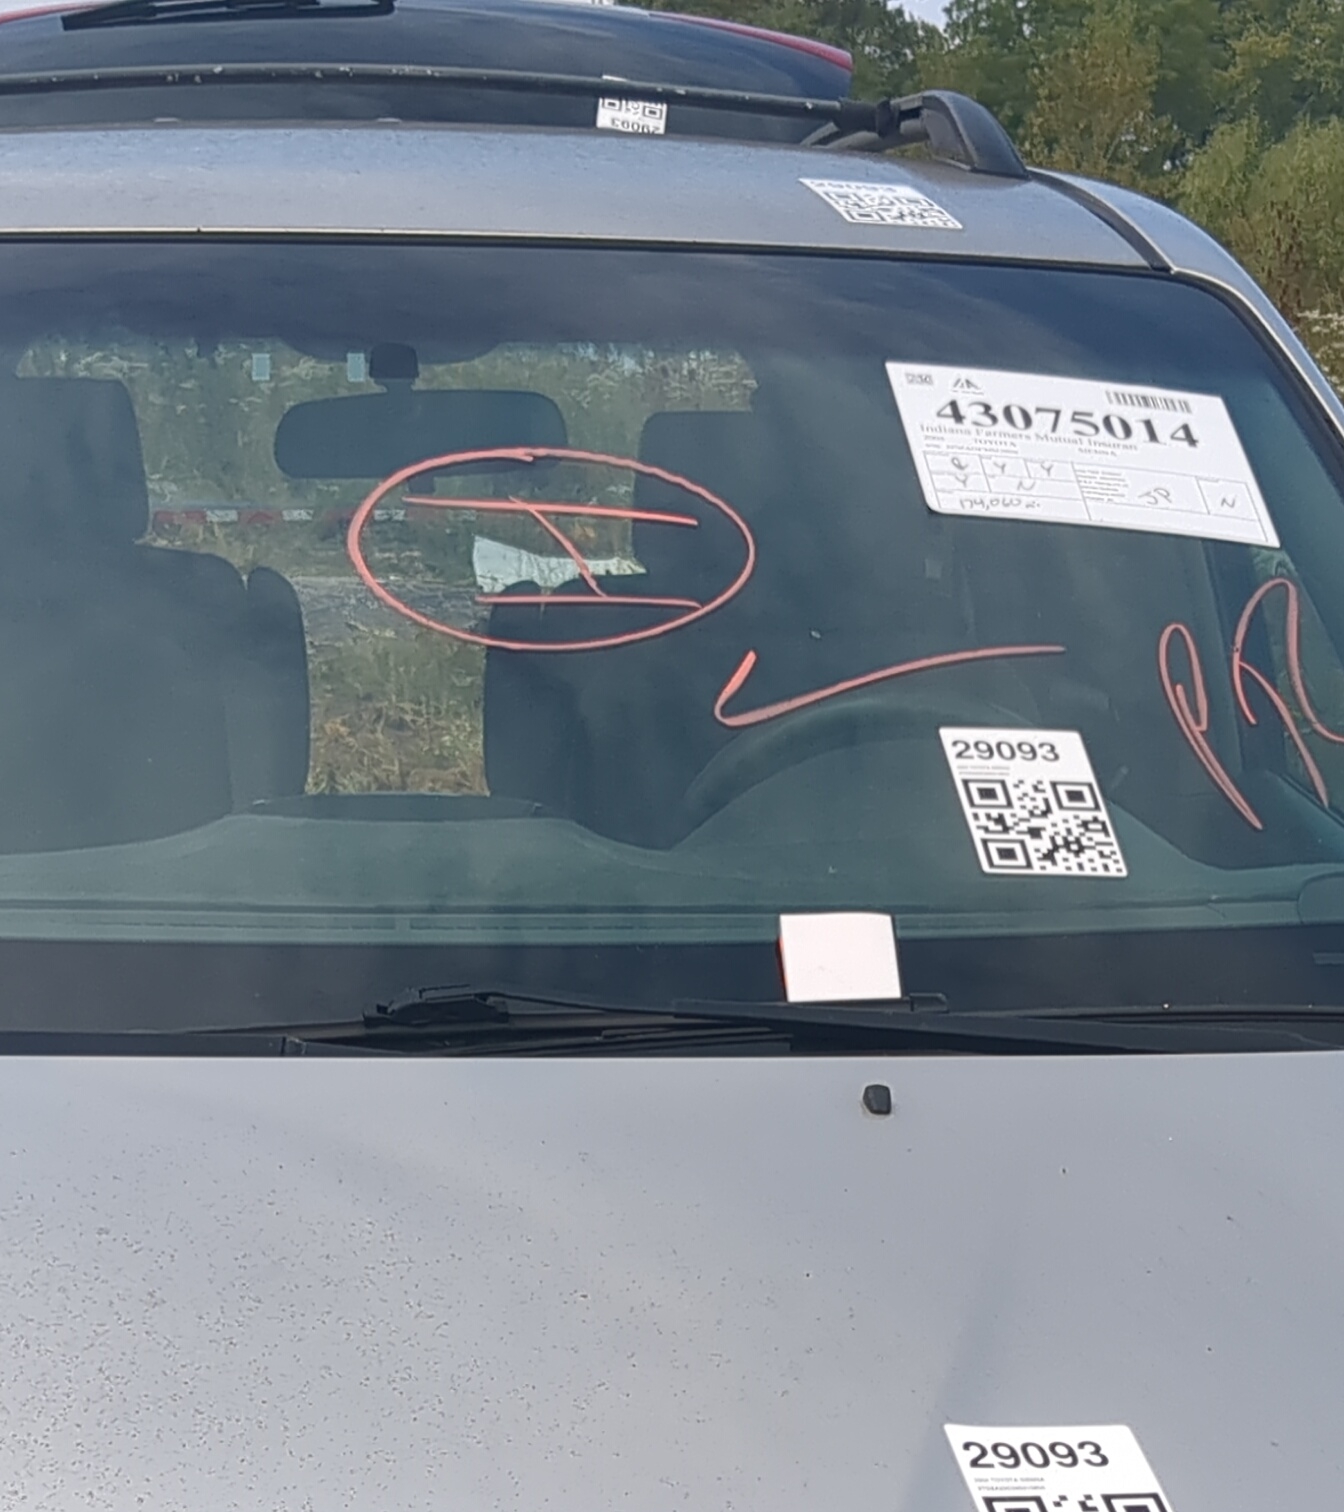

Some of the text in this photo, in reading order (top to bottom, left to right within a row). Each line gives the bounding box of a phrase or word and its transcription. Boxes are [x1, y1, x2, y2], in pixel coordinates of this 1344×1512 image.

[920, 423, 972, 436] Indiana
[975, 427, 1032, 441] Farmers
[1034, 432, 1084, 446] Mutual
[936, 398, 1199, 448] 43075014
[951, 739, 1060, 762] 29093
[962, 1441, 1109, 1469] 29093
